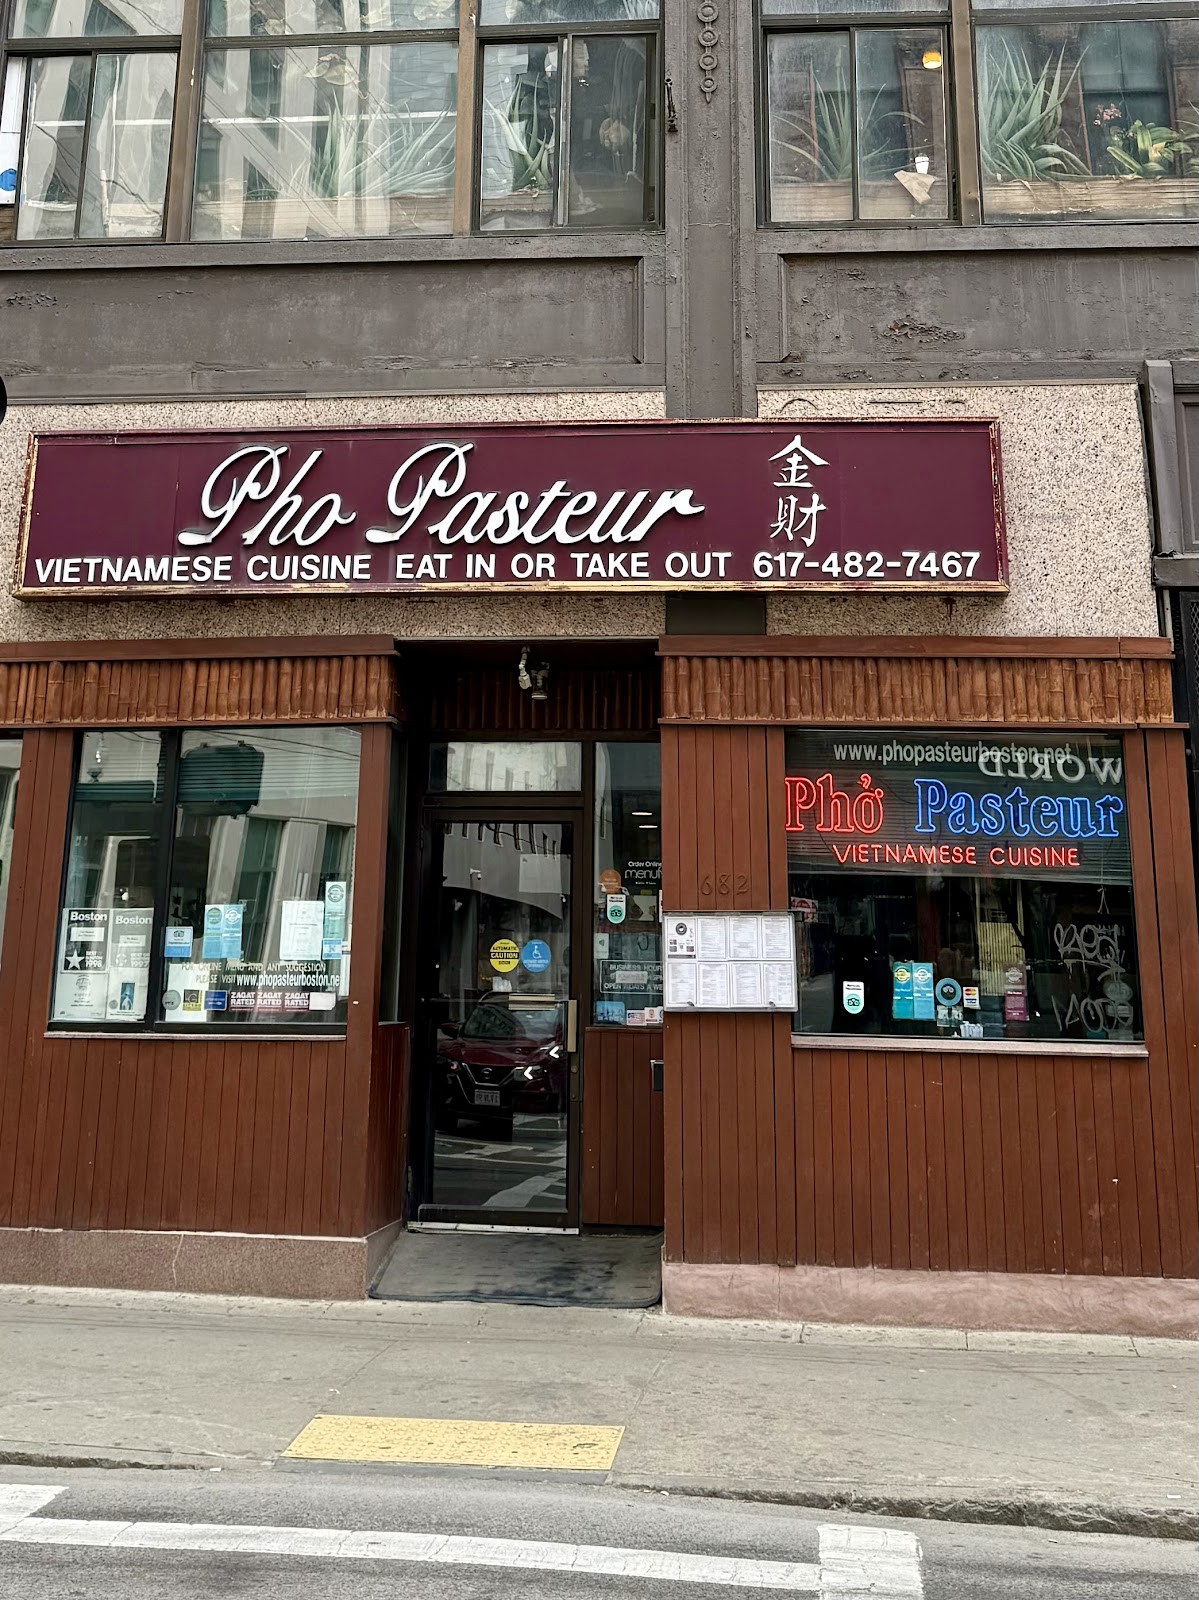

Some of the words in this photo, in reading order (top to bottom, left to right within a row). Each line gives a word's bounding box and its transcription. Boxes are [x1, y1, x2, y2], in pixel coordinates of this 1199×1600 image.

[178, 442, 357, 546] Pho
[365, 442, 705, 545] Pasteur
[768, 434, 829, 548] 金財
[35, 555, 232, 583] VIETNAMESE
[246, 554, 372, 582] CUISINE
[395, 553, 453, 580] EAT
[466, 553, 496, 579] IN
[510, 552, 555, 579] OR
[570, 551, 649, 579] TAKE
[664, 551, 732, 579] OUT
[752, 551, 981, 579] 617-482-7467
[833, 740, 1073, 767] www.phopasteurboston.net
[914, 778, 1124, 838] Pasteur
[832, 843, 977, 865] VIETNAMESE
[989, 847, 1081, 867] CUISINE
[701, 874, 750, 896] 682
[70, 911, 108, 922] Boston
[115, 915, 152, 925] Boston
[198, 962, 222, 971] ONLINE
[247, 962, 263, 972] AND
[267, 963, 281, 972] ANY
[285, 963, 327, 973] SUGGESTION
[196, 974, 218, 984] PLEASE
[221, 975, 236, 984] VISIT
[236, 971, 341, 989] www.phopasteurboston.ne
[603, 982, 622, 990] OPEN
[284, 992, 309, 1000] ZAGAT
